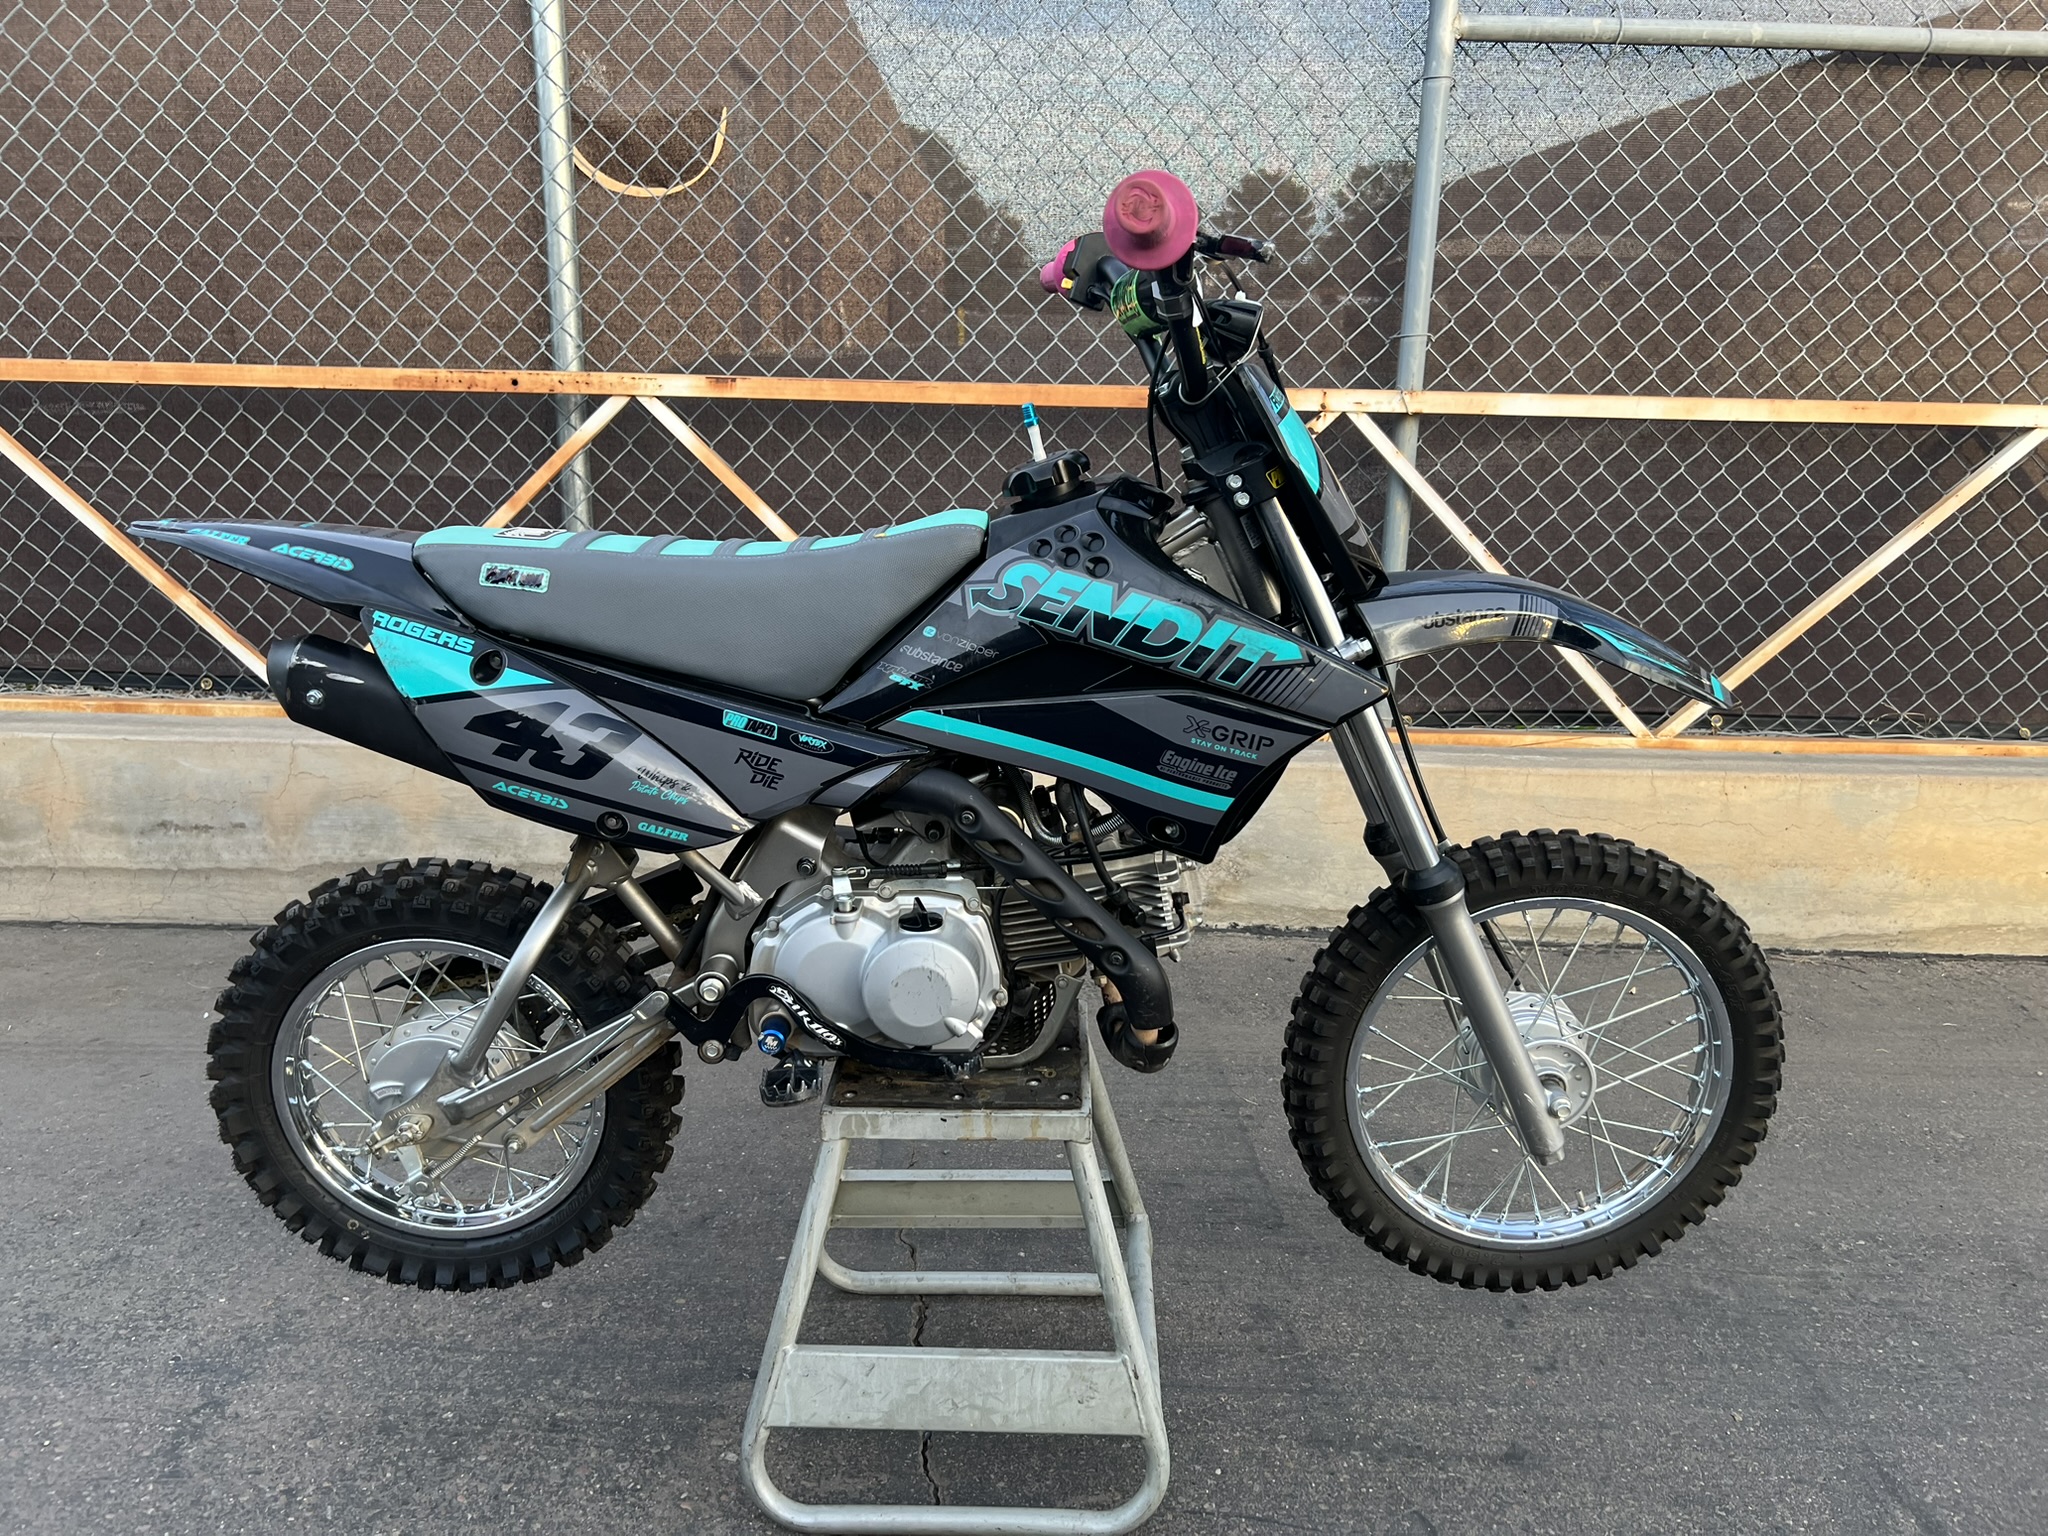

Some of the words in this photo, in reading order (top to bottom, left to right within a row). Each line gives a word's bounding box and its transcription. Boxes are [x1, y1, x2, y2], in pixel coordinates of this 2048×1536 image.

[271, 543, 355, 571] ACERBIS
[372, 610, 475, 653] ROGERS
[968, 562, 1304, 687] SENDIT
[899, 644, 964, 673] substance
[937, 630, 1000, 659] vonzipper
[1183, 715, 1275, 752] X-GRIP
[1191, 738, 1213, 749] STAY
[1214, 744, 1227, 753] ON
[1229, 748, 1259, 760] TRACK
[1162, 750, 1216, 776] Engine
[1213, 764, 1238, 781] Ice
[492, 781, 570, 810] ACERBIS
[628, 780, 659, 796] Potato
[661, 789, 689, 805] Chips
[637, 821, 689, 842] GALFER
